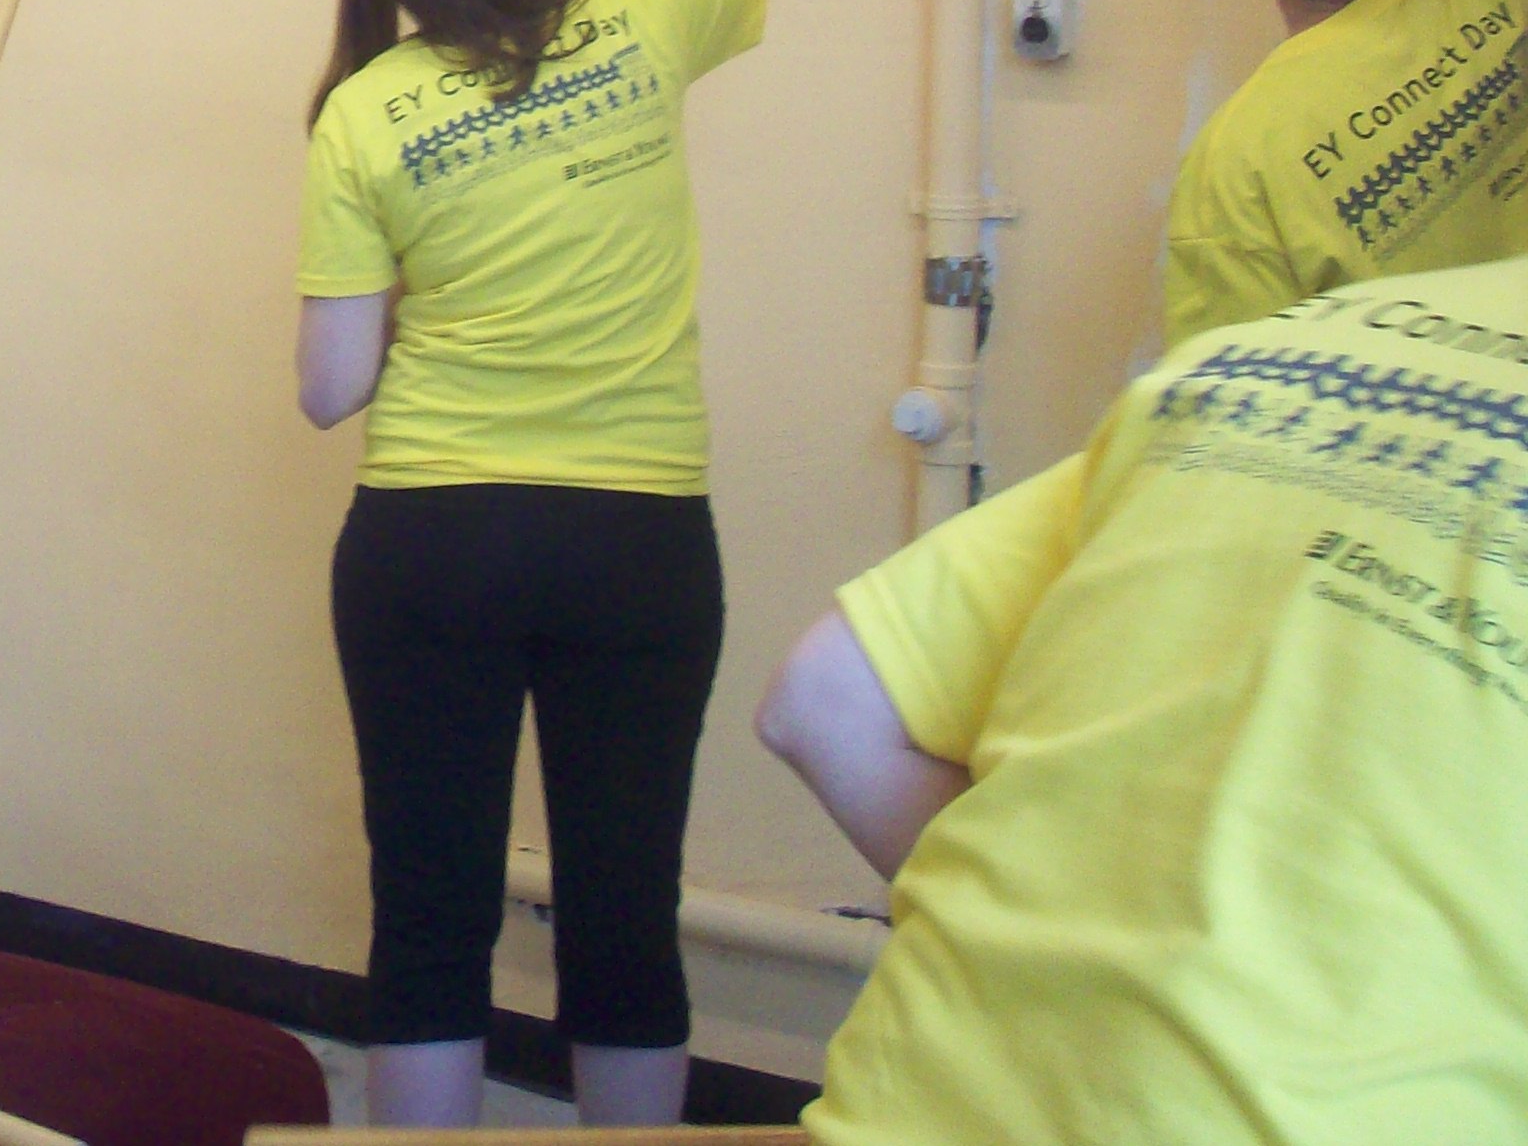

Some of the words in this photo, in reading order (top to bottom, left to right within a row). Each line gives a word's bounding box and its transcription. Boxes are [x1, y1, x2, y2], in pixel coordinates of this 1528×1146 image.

[383, 84, 423, 125] EY
[1302, 131, 1344, 181] EY
[1348, 45, 1468, 141] Connect
[1458, 1, 1518, 51] Day
[1360, 299, 1528, 364] Conn
